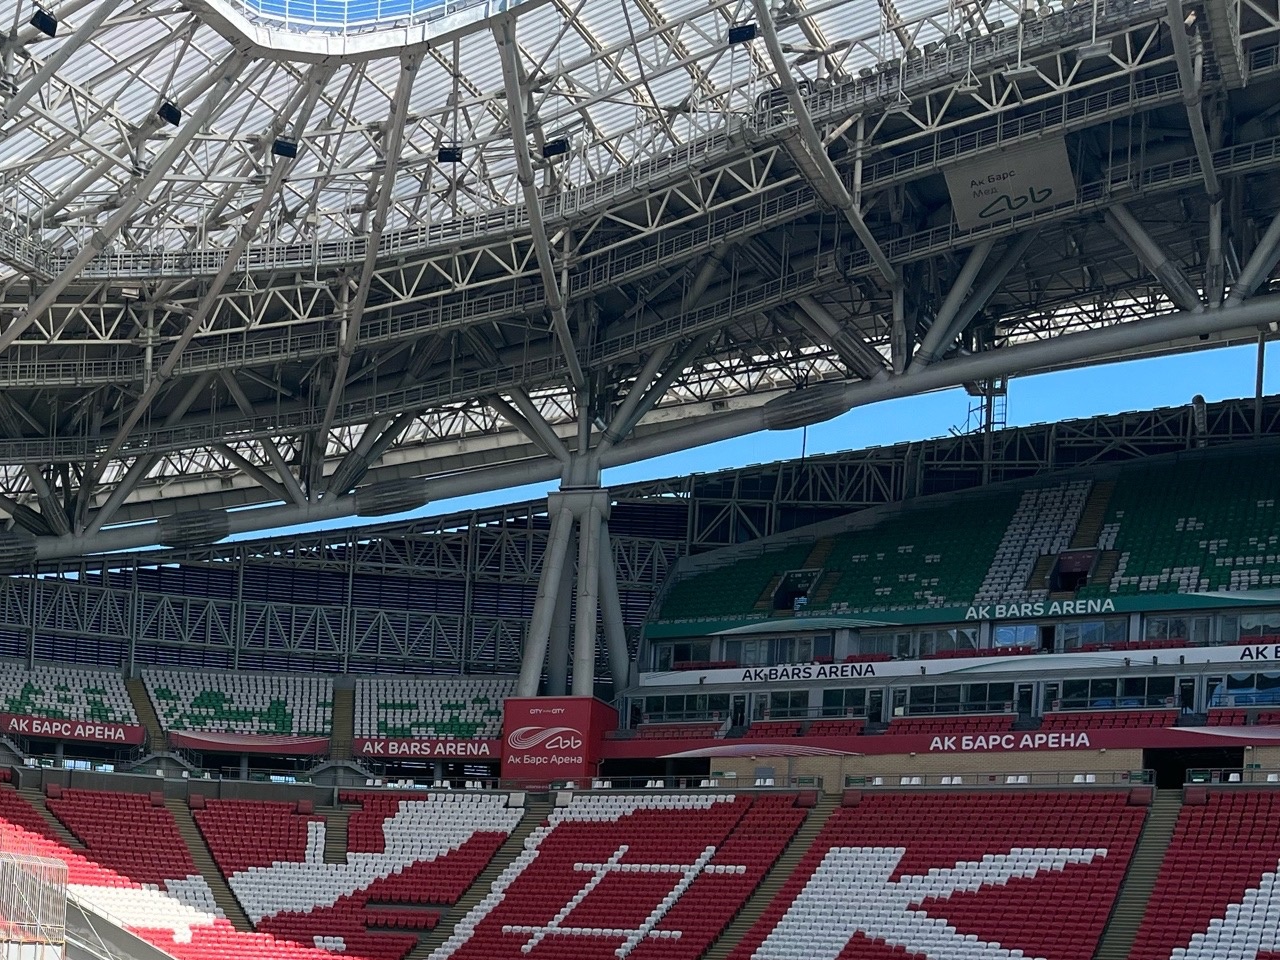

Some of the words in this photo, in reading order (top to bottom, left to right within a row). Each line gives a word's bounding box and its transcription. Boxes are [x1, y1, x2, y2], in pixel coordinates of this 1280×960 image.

[970, 179, 985, 189] Ак
[987, 170, 1016, 184] Барс
[965, 605, 990, 620] AK
[995, 602, 1044, 618] BARS
[1048, 598, 1115, 615] ARENA
[1240, 646, 1268, 660] AK
[742, 668, 765, 681] AK
[768, 667, 812, 680] BARS
[816, 664, 875, 678] ARENA
[8, 718, 29, 732] АК
[32, 720, 71, 736] БАРС
[74, 724, 125, 740] АРЕНА
[362, 741, 385, 754] AK
[388, 742, 431, 755] BARS
[434, 742, 490, 756] ARENA
[929, 736, 957, 751] АК
[961, 734, 1015, 750] БАРС
[1019, 732, 1090, 748] АРЕНА
[507, 755, 521, 764] Ак
[523, 755, 548, 765] Барс
[550, 754, 583, 765] Арена
